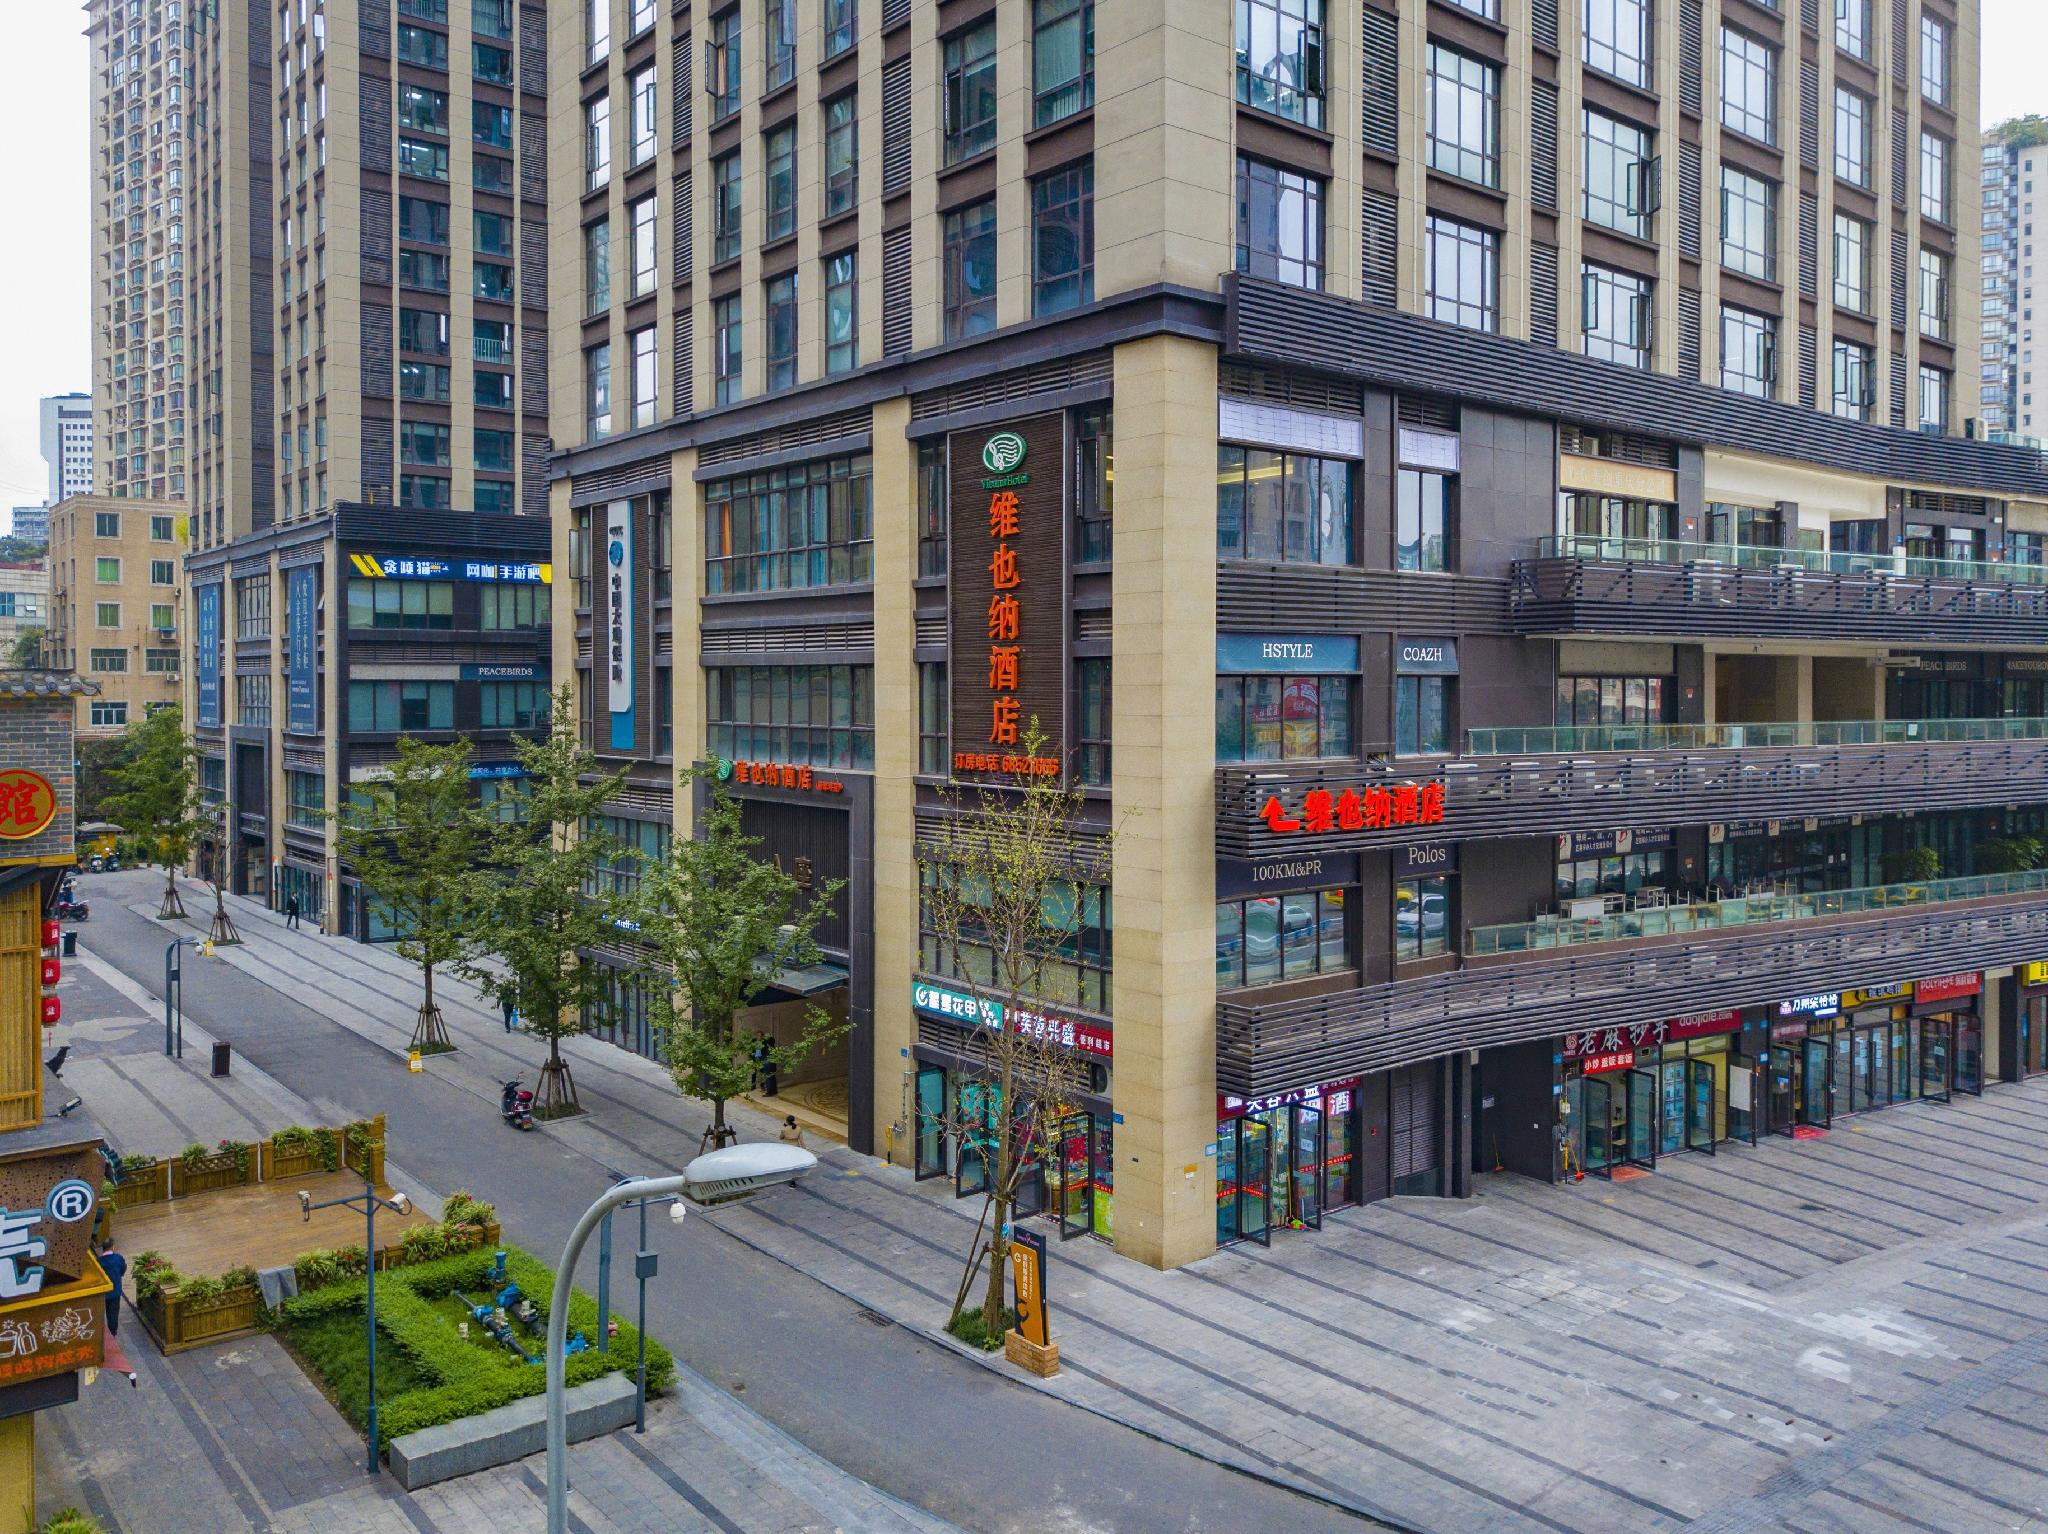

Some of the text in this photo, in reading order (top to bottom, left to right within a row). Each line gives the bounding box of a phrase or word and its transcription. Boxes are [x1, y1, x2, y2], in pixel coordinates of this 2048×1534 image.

[989, 491, 1021, 745] 维也纳酒店
[1262, 642, 1313, 659] HSTYLE
[1403, 647, 1442, 662] COAZH
[478, 667, 533, 676] PEACEBIRDS
[735, 759, 813, 791] 维也纳酒店
[1304, 782, 1446, 832] 维也纳酒店
[1408, 845, 1446, 865] Polos
[1252, 859, 1322, 882] 100KM&PR
[1080, 1034, 1111, 1052] 便利超市
